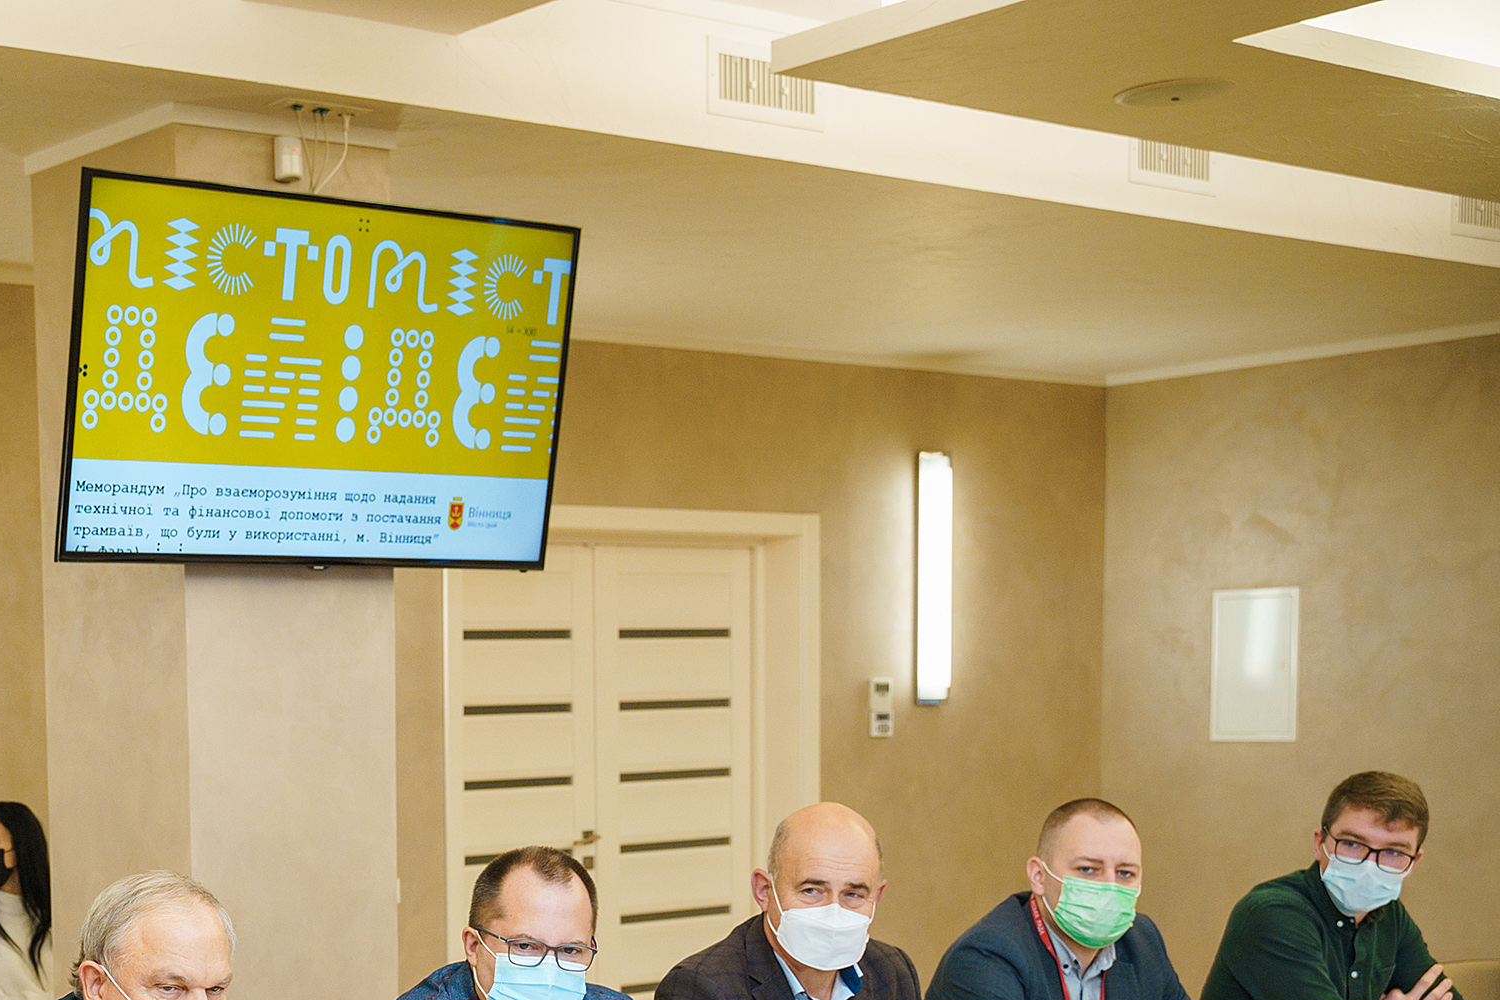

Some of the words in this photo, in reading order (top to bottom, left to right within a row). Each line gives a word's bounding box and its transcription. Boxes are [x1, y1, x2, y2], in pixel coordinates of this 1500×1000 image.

[75, 480, 165, 496] Меморандум
[215, 487, 338, 502] взаєморозуміння
[345, 492, 376, 503] щодо
[384, 493, 436, 504] надання
[75, 504, 153, 516] технічної
[163, 506, 179, 516] та
[188, 505, 271, 519] фінансової
[280, 510, 343, 522] допомоги
[351, 512, 358, 522] з
[366, 513, 441, 525] постачання
[73, 524, 150, 539] трамваїв,
[161, 527, 178, 538] що
[187, 526, 220, 540] були
[229, 529, 237, 539] у
[245, 529, 347, 544] використанні,
[357, 534, 370, 542] м.
